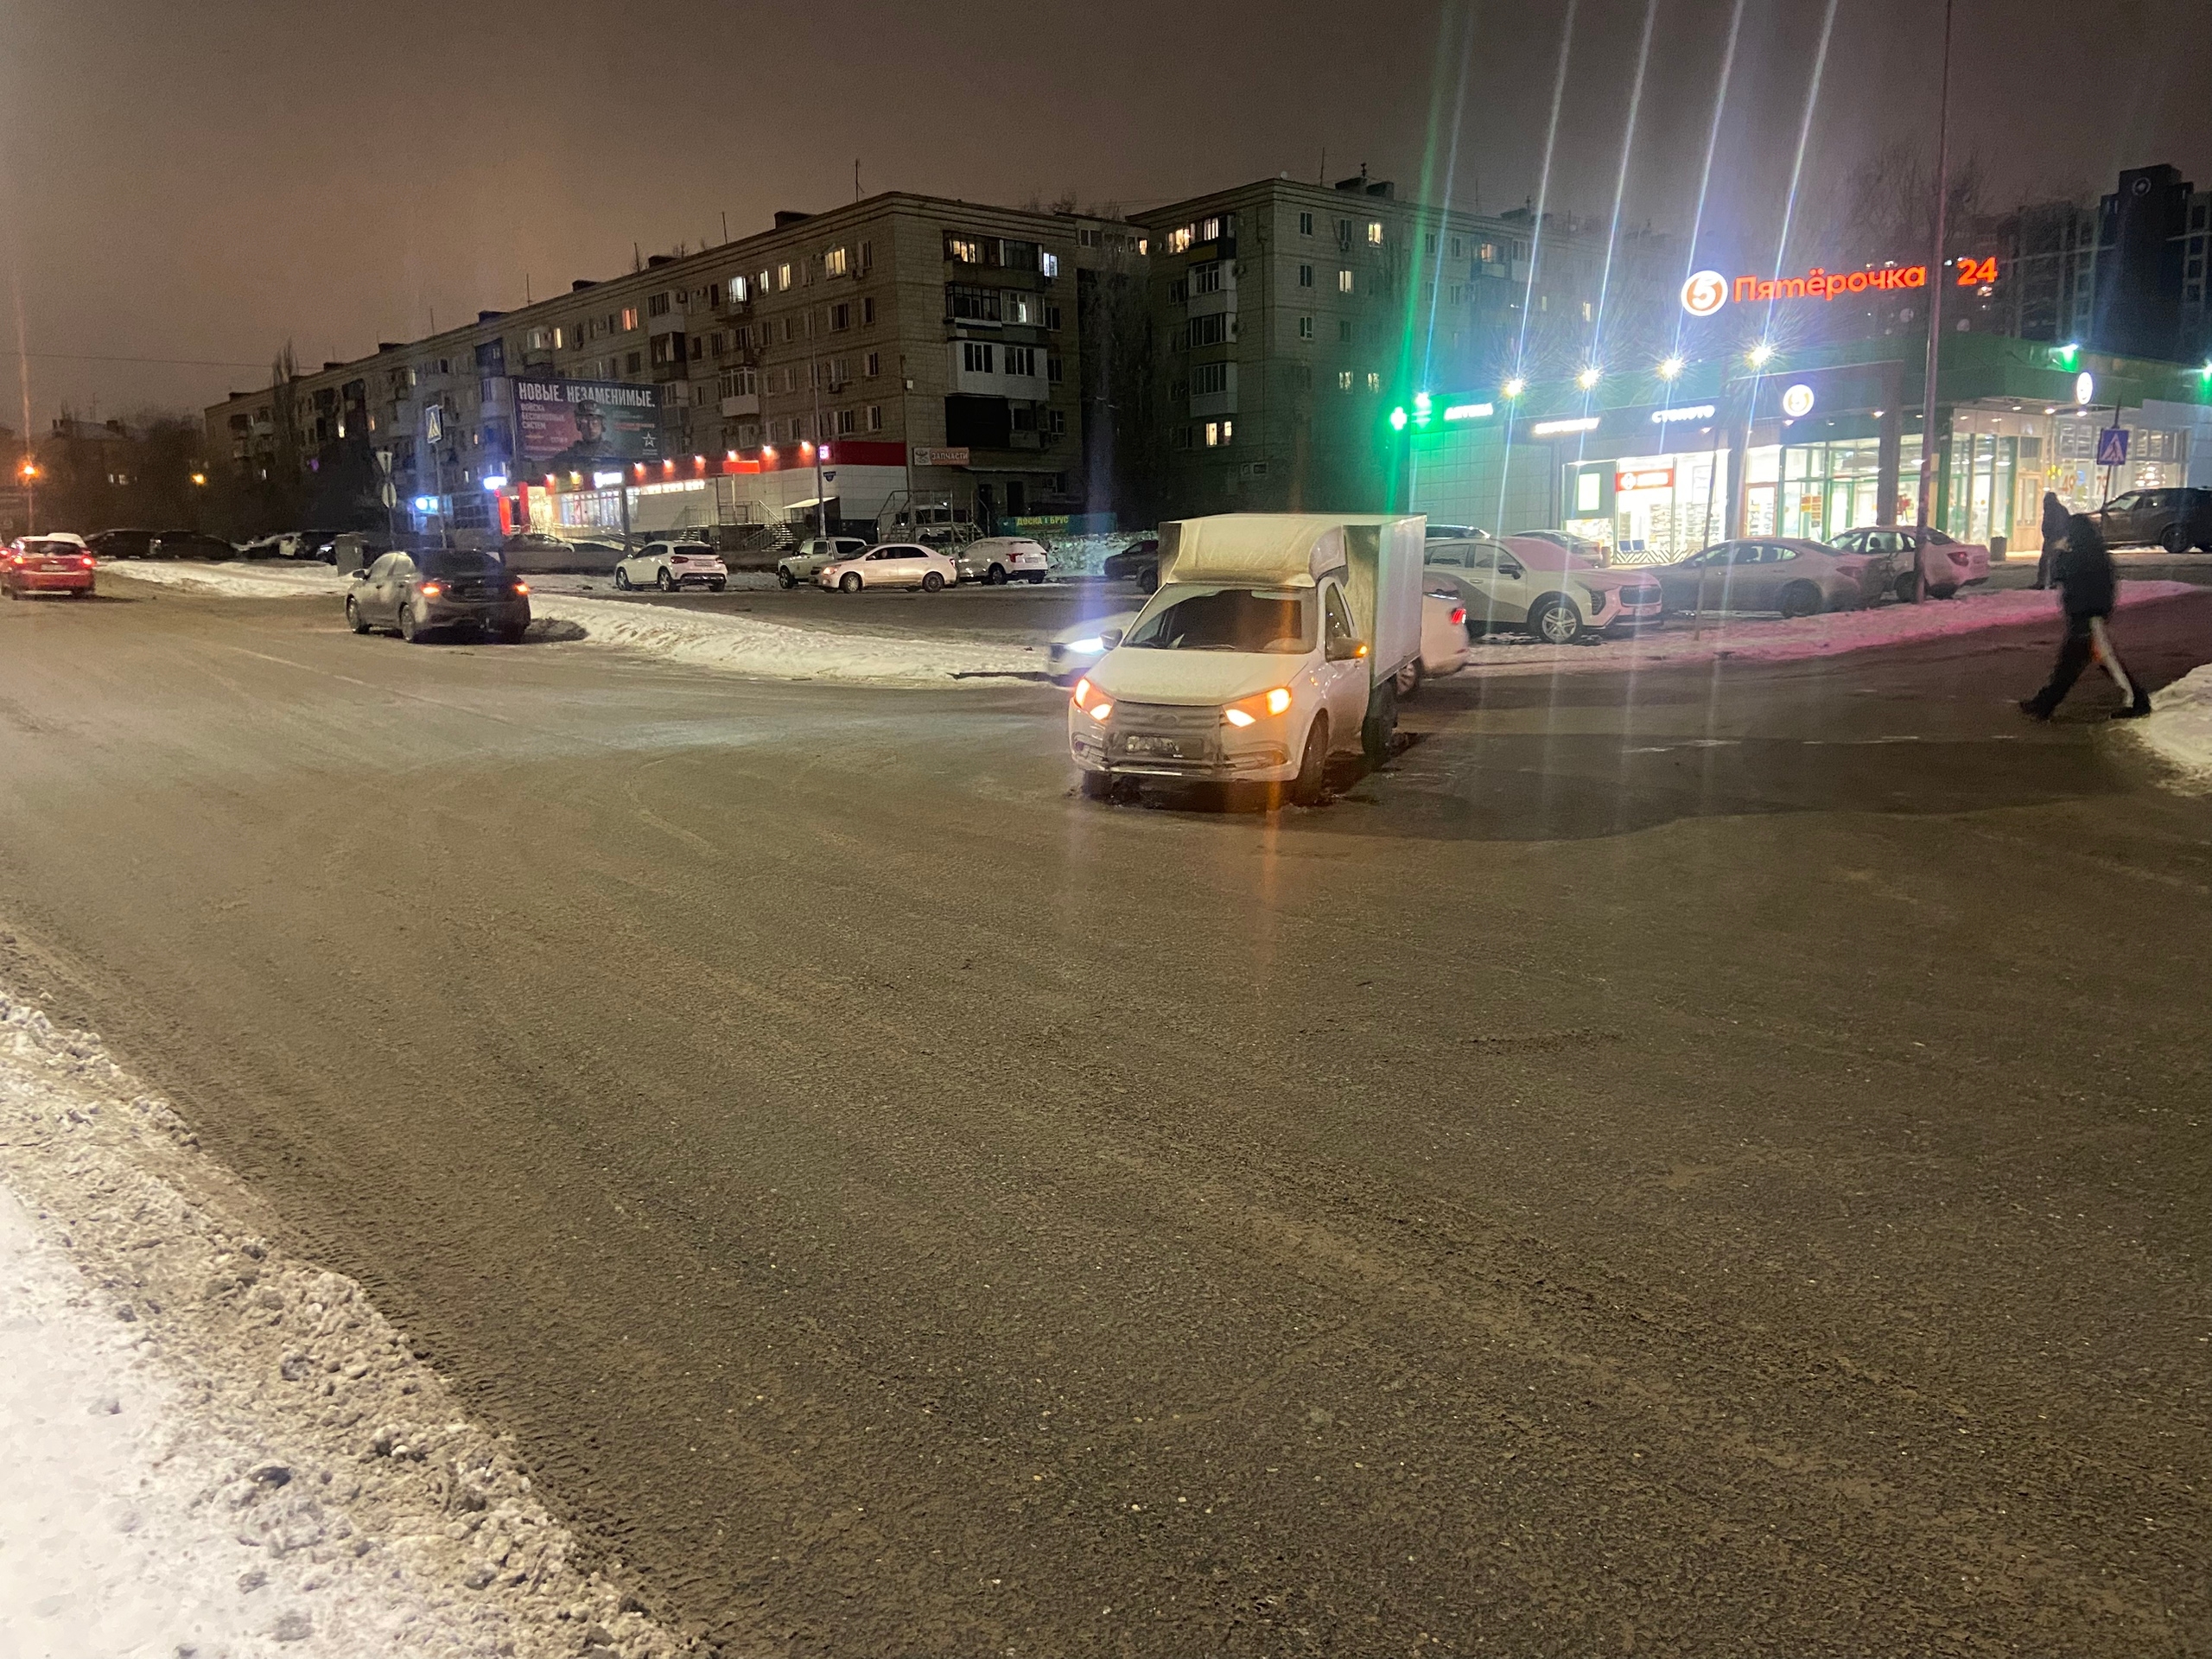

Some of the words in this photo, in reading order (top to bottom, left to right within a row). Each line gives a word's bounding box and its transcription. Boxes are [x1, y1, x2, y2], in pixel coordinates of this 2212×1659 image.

[1688, 273, 1723, 313] 5
[1732, 267, 1927, 302] Пятёрочка
[1956, 257, 1999, 286] 24
[519, 382, 563, 403] НОВЫЕ.
[567, 385, 656, 408] НЕЗАМЕНИМЫЕ.
[931, 452, 969, 461] ЗАПЧАСТИ
[1016, 516, 1043, 526] ДОСКА
[1049, 516, 1069, 524] БРУС
